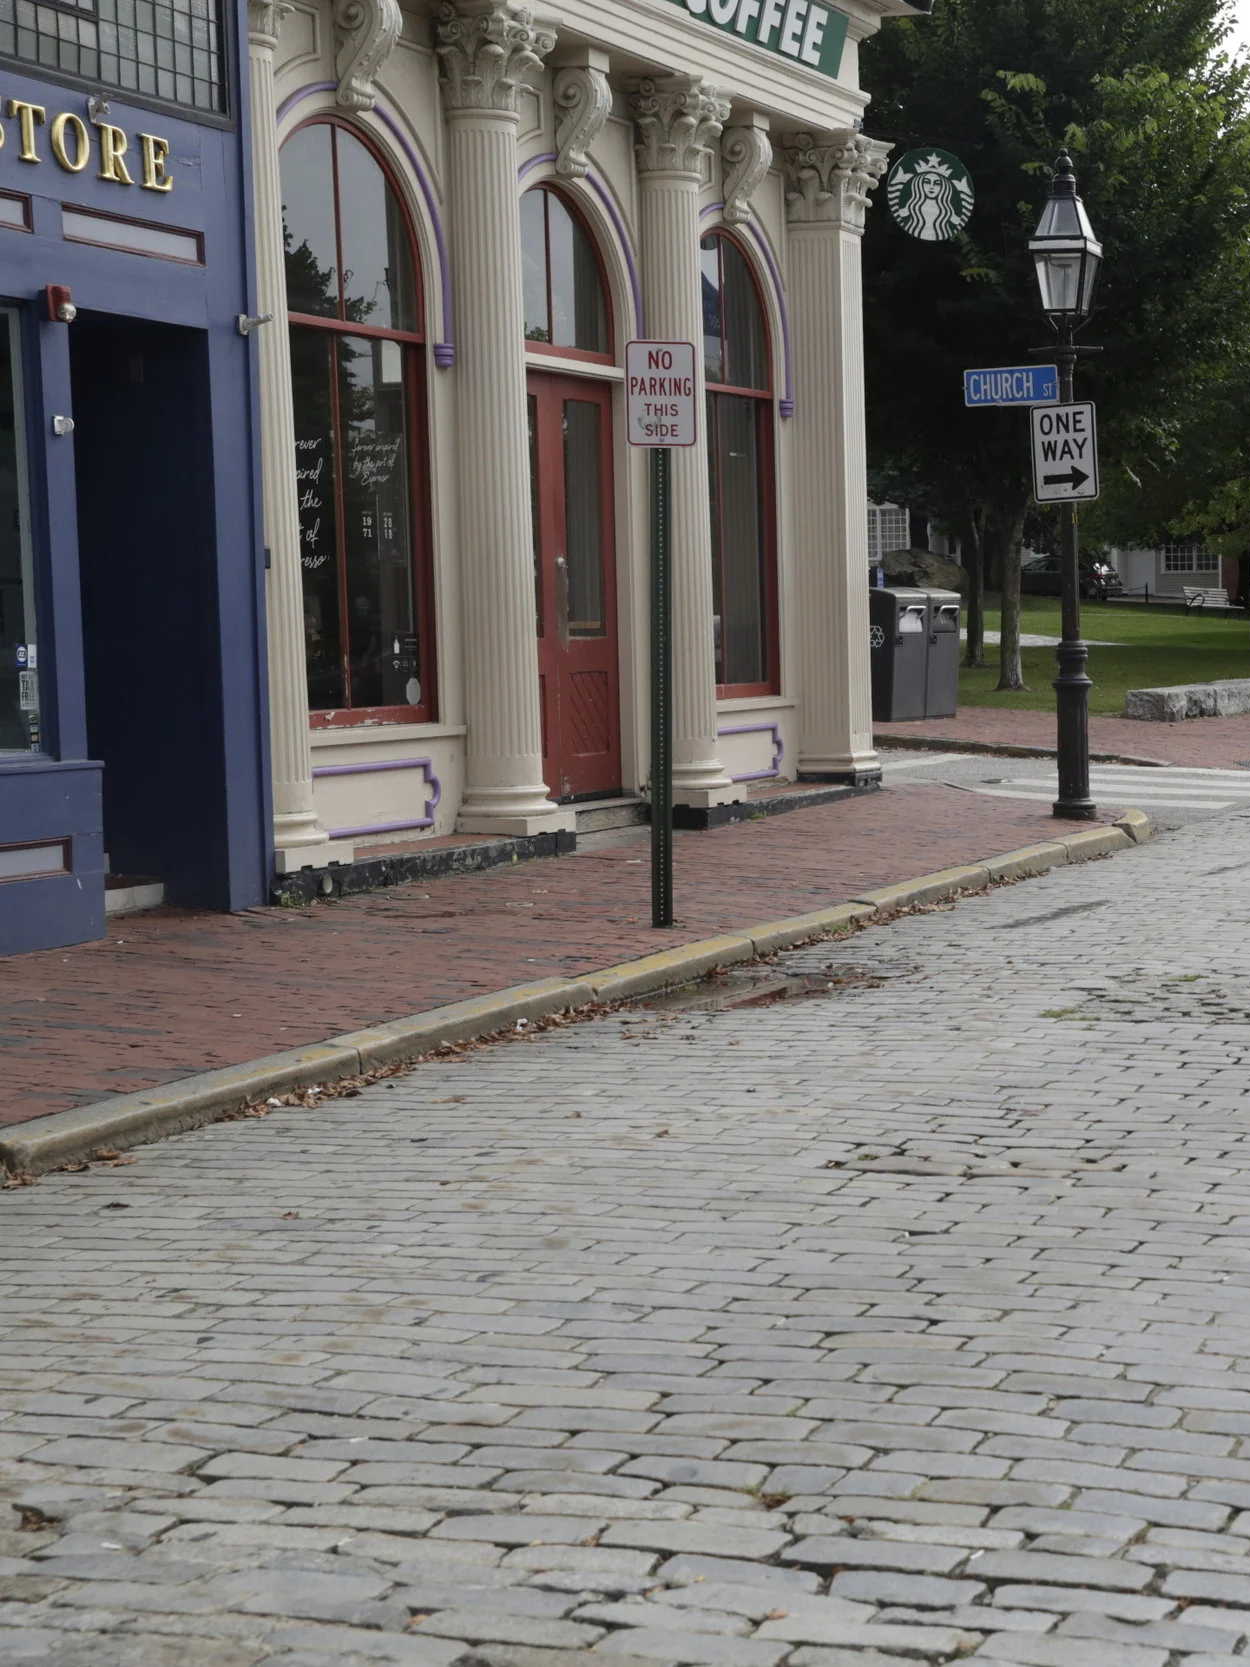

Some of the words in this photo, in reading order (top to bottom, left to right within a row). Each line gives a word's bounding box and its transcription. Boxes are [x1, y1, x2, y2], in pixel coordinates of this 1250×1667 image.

[0, 98, 174, 193] TORE
[647, 350, 673, 370] NO
[630, 376, 692, 397] PARKING
[969, 371, 1034, 400] CHURCH
[1042, 383, 1053, 397] ST
[644, 403, 679, 417] THIS
[644, 423, 679, 438] SIDE
[1039, 411, 1086, 436] ONE
[294, 438, 322, 450] rever
[1041, 437, 1088, 462] WAY
[300, 489, 322, 510] the
[362, 517, 372, 526] 19
[362, 528, 372, 538] 71
